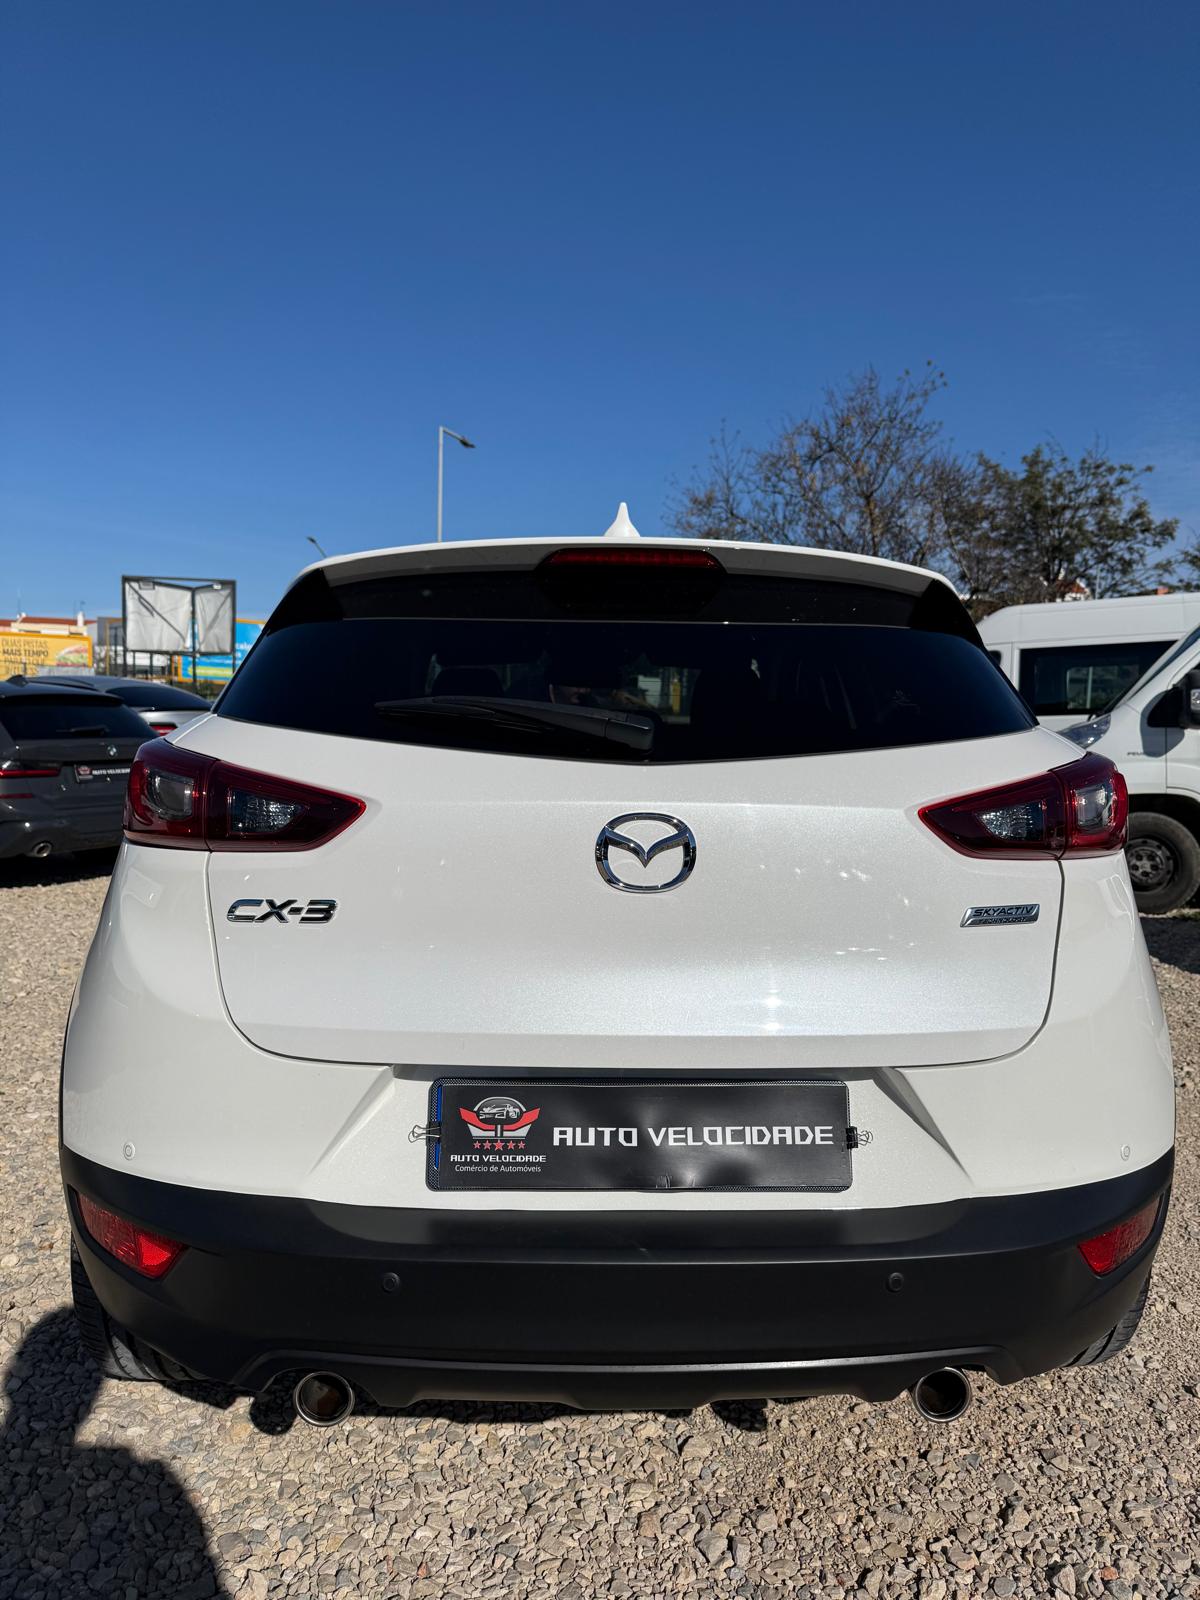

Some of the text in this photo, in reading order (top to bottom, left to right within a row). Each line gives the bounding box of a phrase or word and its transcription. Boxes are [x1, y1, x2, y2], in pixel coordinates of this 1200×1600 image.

[2, 648, 48, 657] MAIS TEMPO
[227, 899, 337, 924] CX-3
[973, 906, 1034, 917] SKYACTIV
[553, 1126, 834, 1147] AUTO VELOCIDADE
[450, 1154, 547, 1163] AUTO VELOCIDADE
[455, 1164, 542, 1172] Comércio de Automóveis
